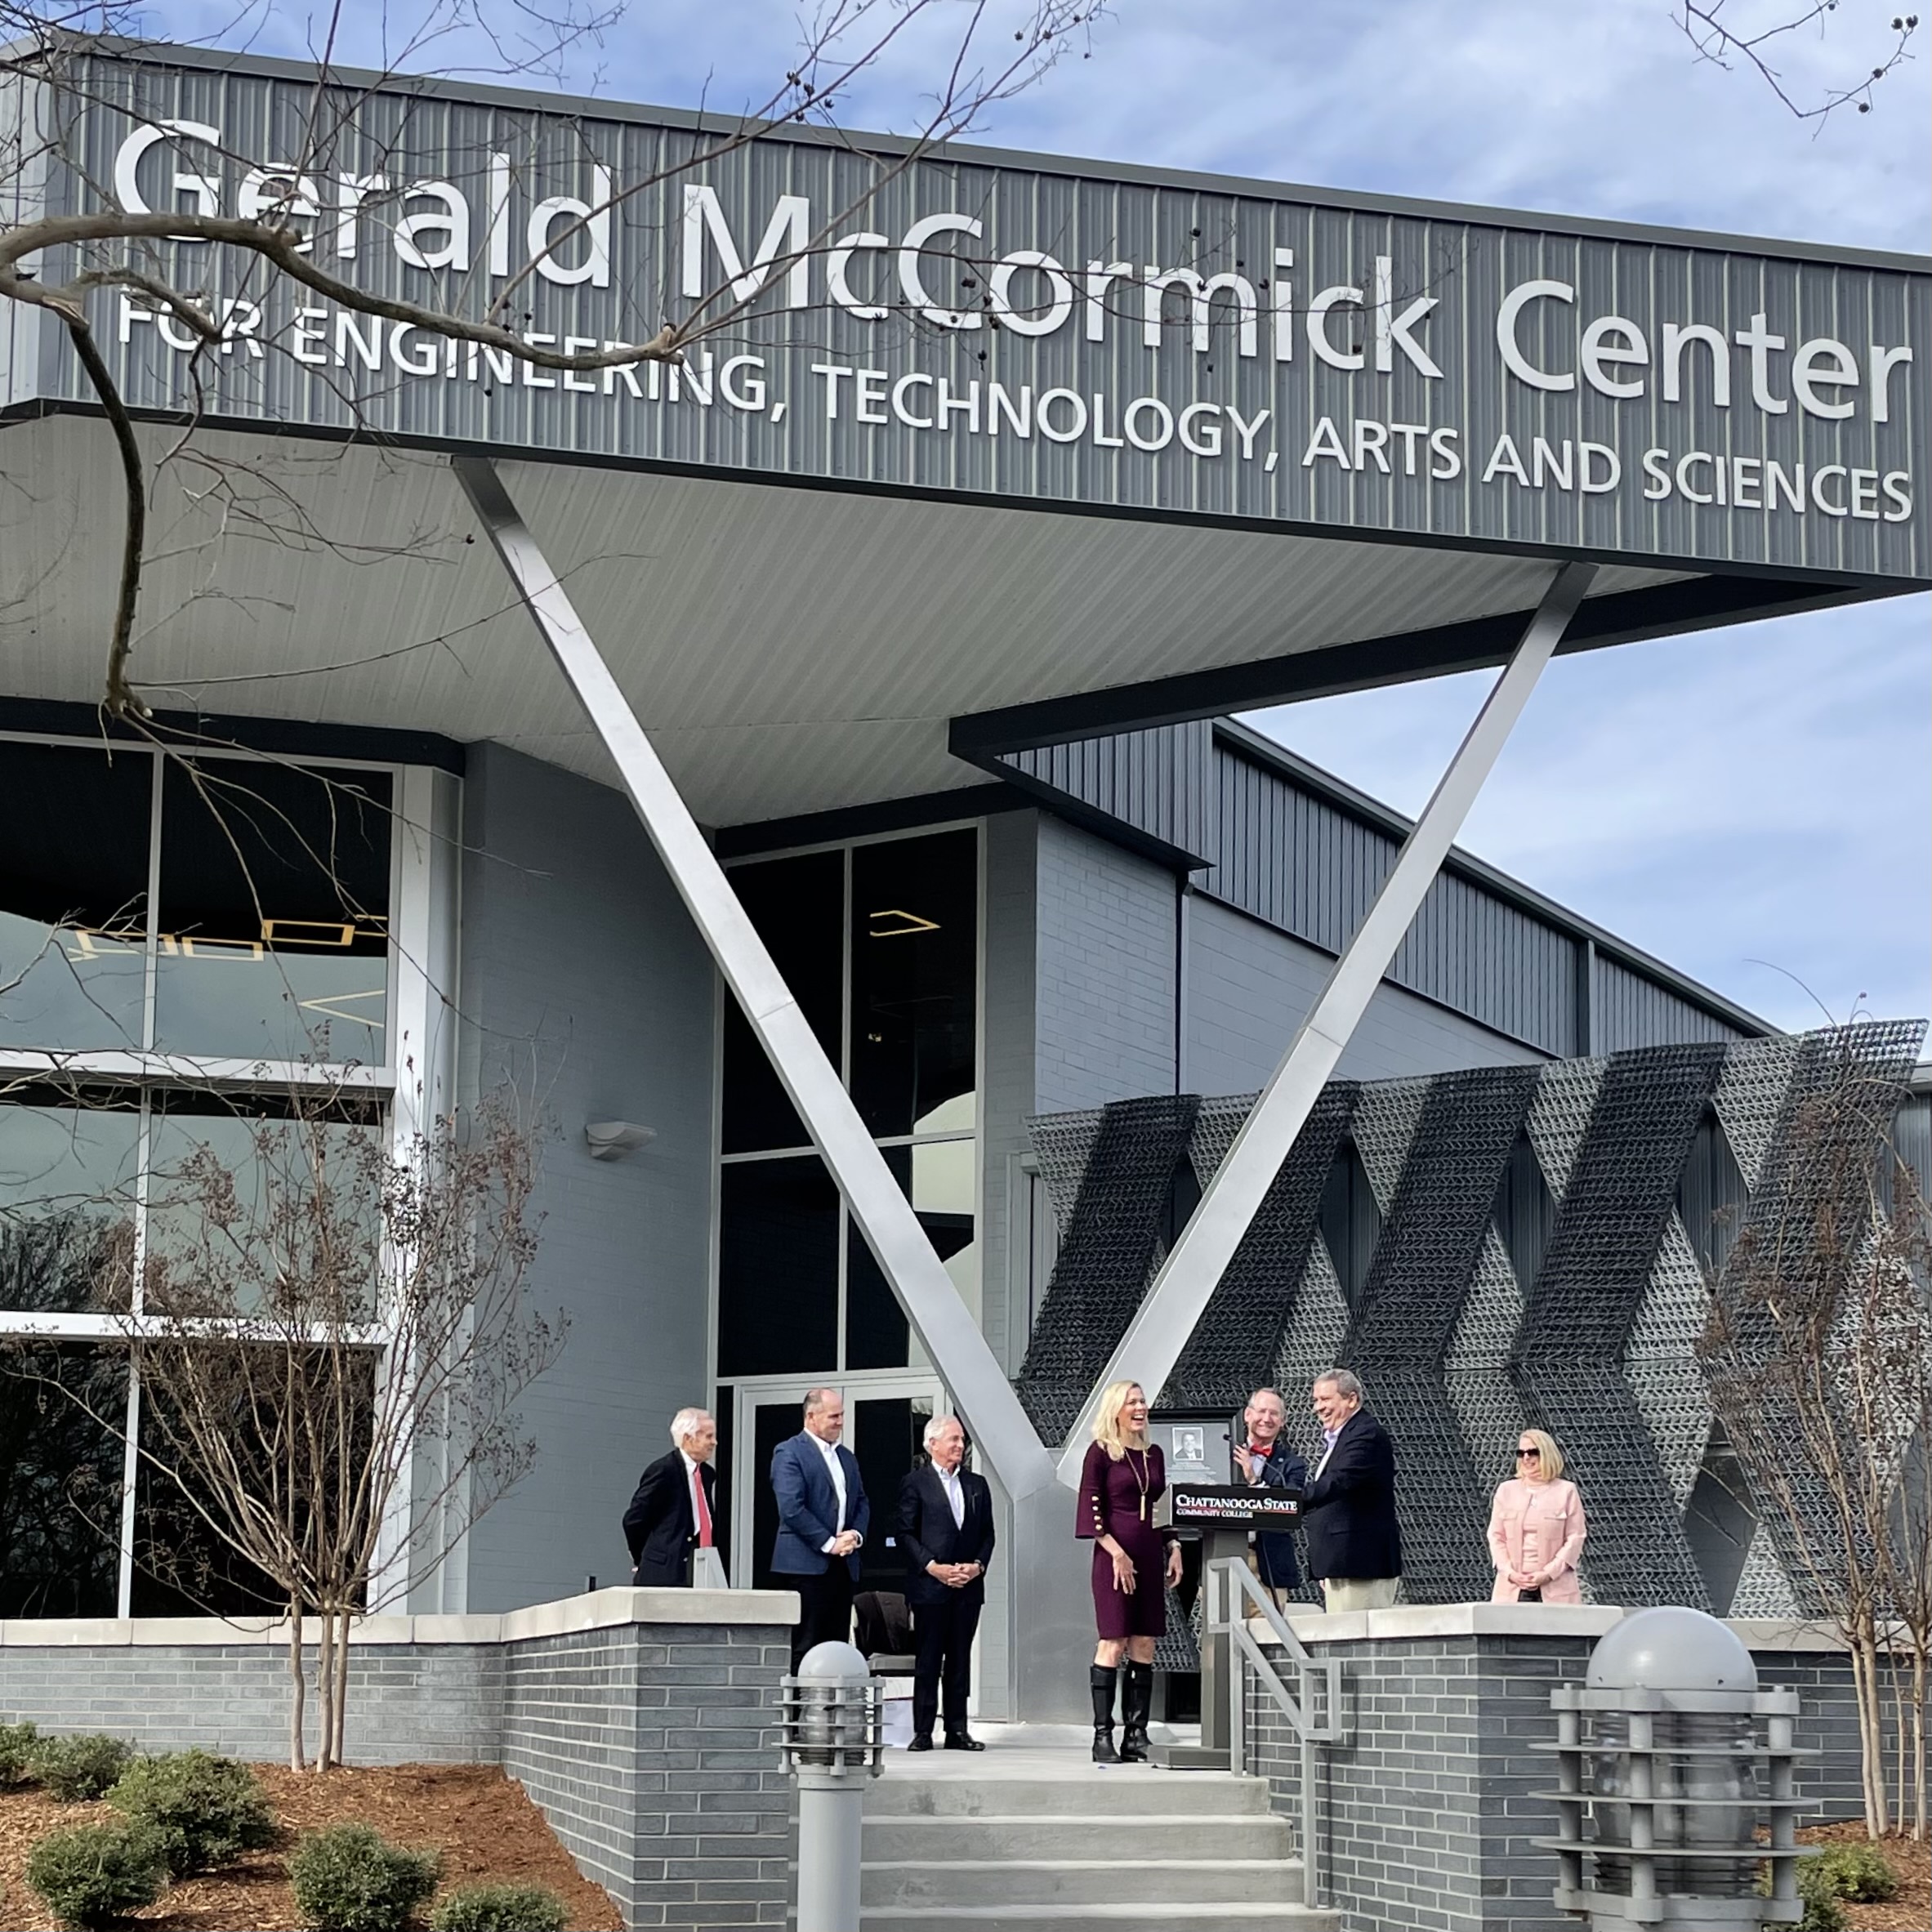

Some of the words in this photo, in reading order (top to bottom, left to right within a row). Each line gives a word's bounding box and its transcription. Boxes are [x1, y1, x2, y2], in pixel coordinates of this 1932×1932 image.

[114, 118, 611, 288] Gerald
[682, 183, 1444, 379] McCormick
[1497, 279, 1913, 423] Center
[118, 286, 264, 358] FOR
[293, 307, 785, 422] ENGINEERING,
[811, 364, 1278, 472] TECHNOLOGY,
[1302, 417, 1461, 480] ARTS
[1481, 434, 1621, 493] AND
[1642, 448, 1913, 523] SCIENCES
[1176, 1494, 1263, 1510] CHATTANOOGA
[1263, 1498, 1297, 1511] STATE
[1176, 1508, 1220, 1517] COMMUNITY
[1221, 1510, 1253, 1519] COLLEGE
